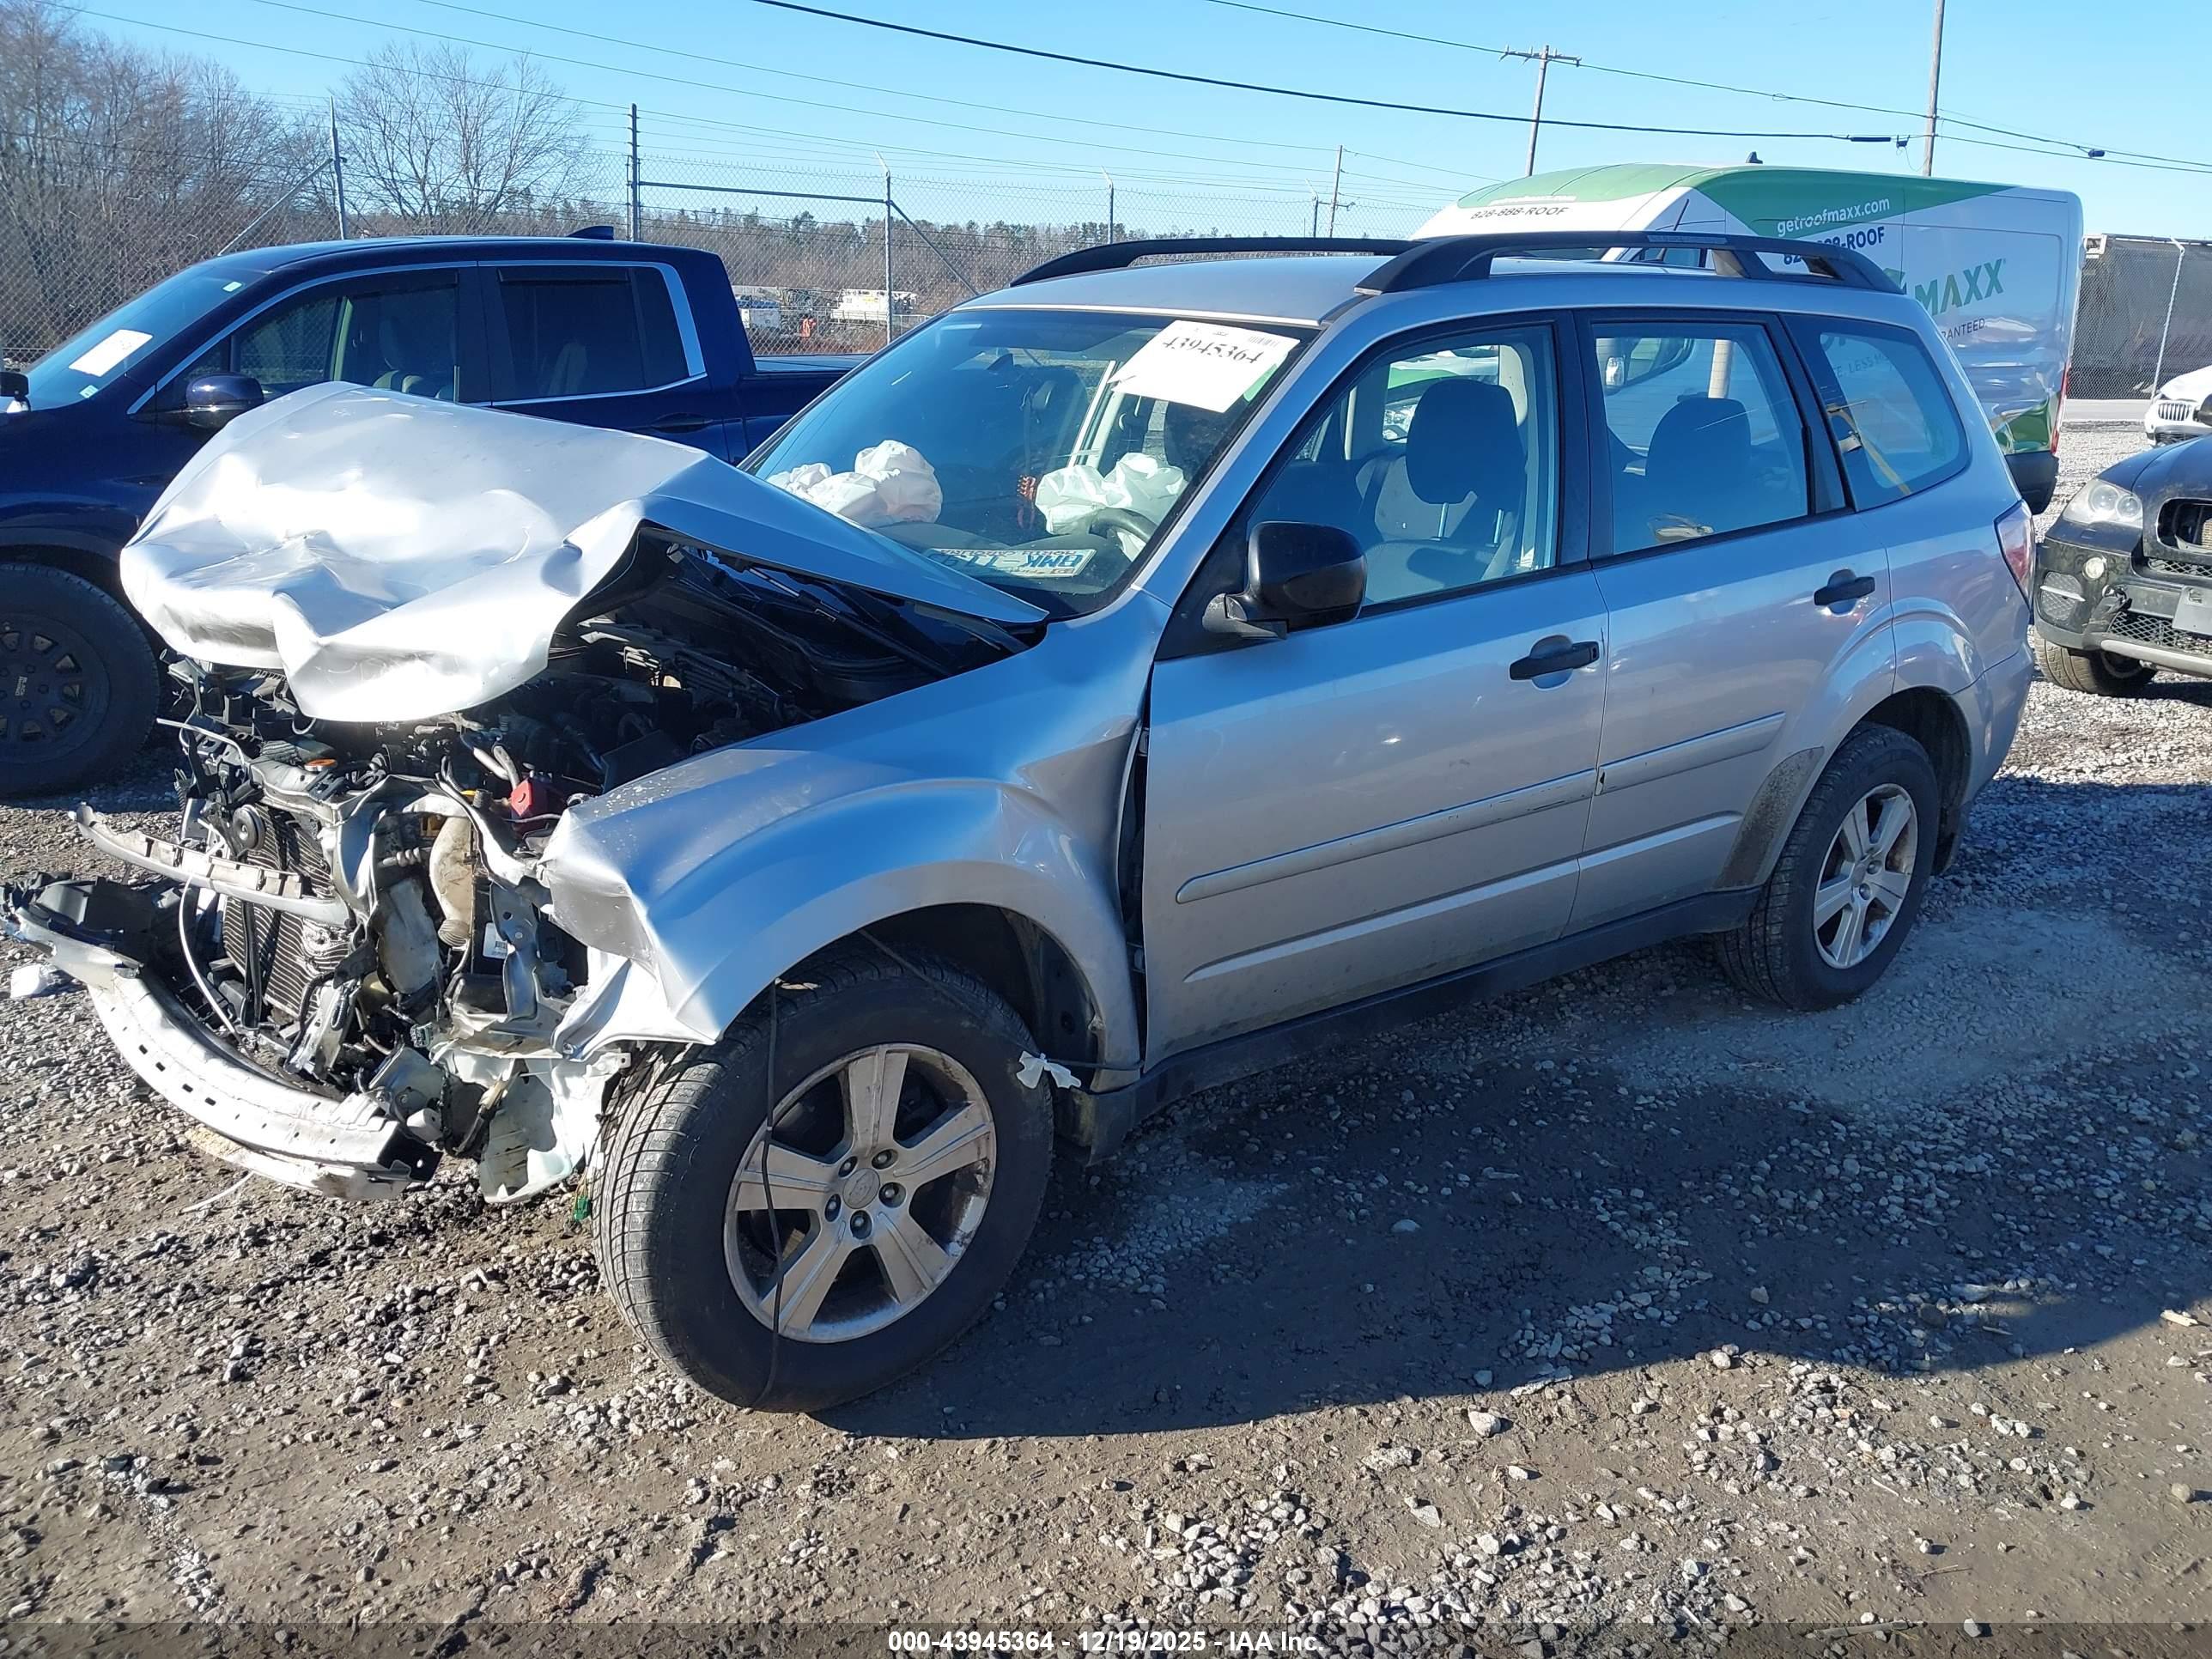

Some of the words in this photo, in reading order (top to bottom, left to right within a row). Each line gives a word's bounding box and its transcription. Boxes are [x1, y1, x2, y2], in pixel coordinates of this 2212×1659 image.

[1777, 198, 1890, 237] getroofmaxx.com
[1915, 258, 2004, 317] MAXX
[1163, 336, 1265, 364] 43945364
